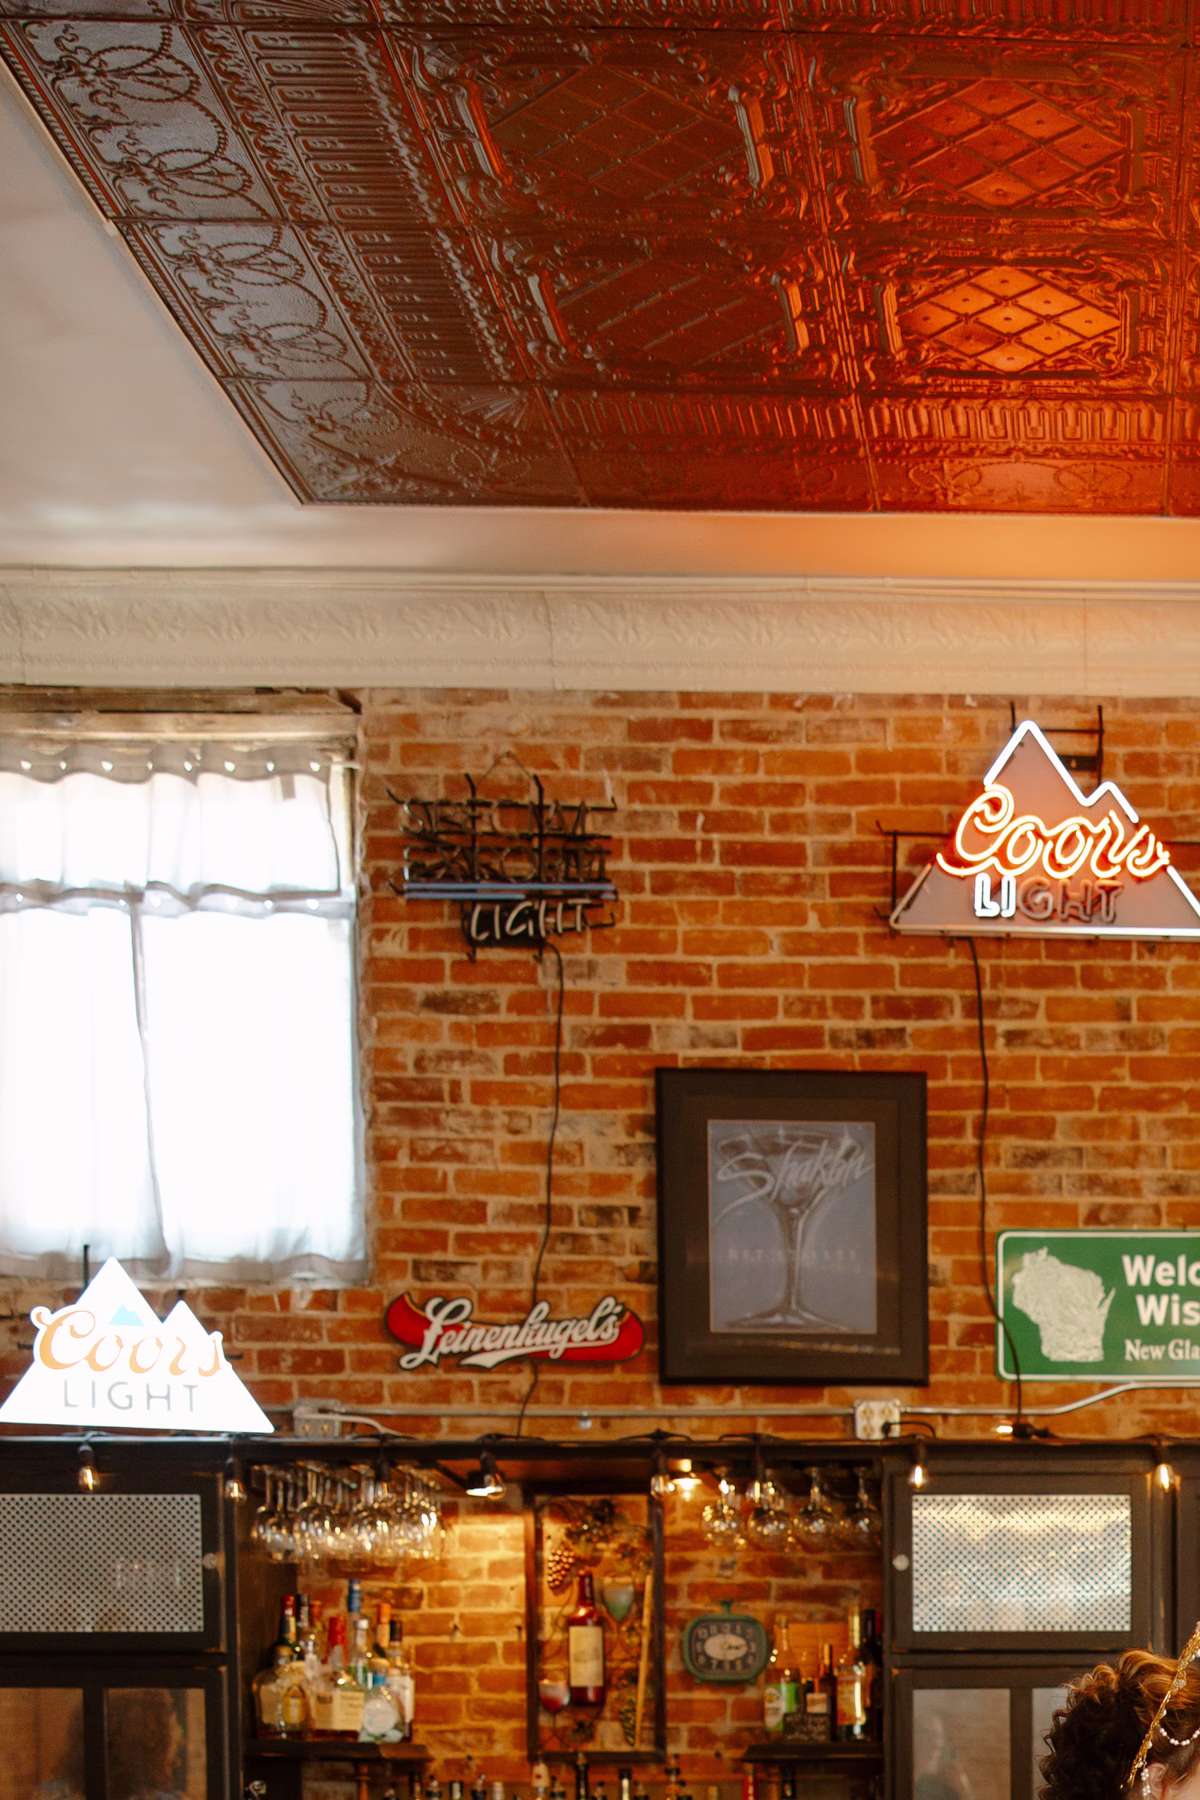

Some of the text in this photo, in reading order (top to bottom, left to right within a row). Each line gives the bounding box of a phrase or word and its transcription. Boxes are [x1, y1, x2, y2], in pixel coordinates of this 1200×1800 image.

[936, 783, 1171, 880] Coors
[470, 899, 594, 941] LIGHT
[973, 871, 1124, 924] LIGHT
[35, 1310, 222, 1377] Coors
[400, 1296, 626, 1370] Leinenkugel's
[1124, 1338, 1167, 1362] New
[63, 1379, 199, 1413] LIGHT
